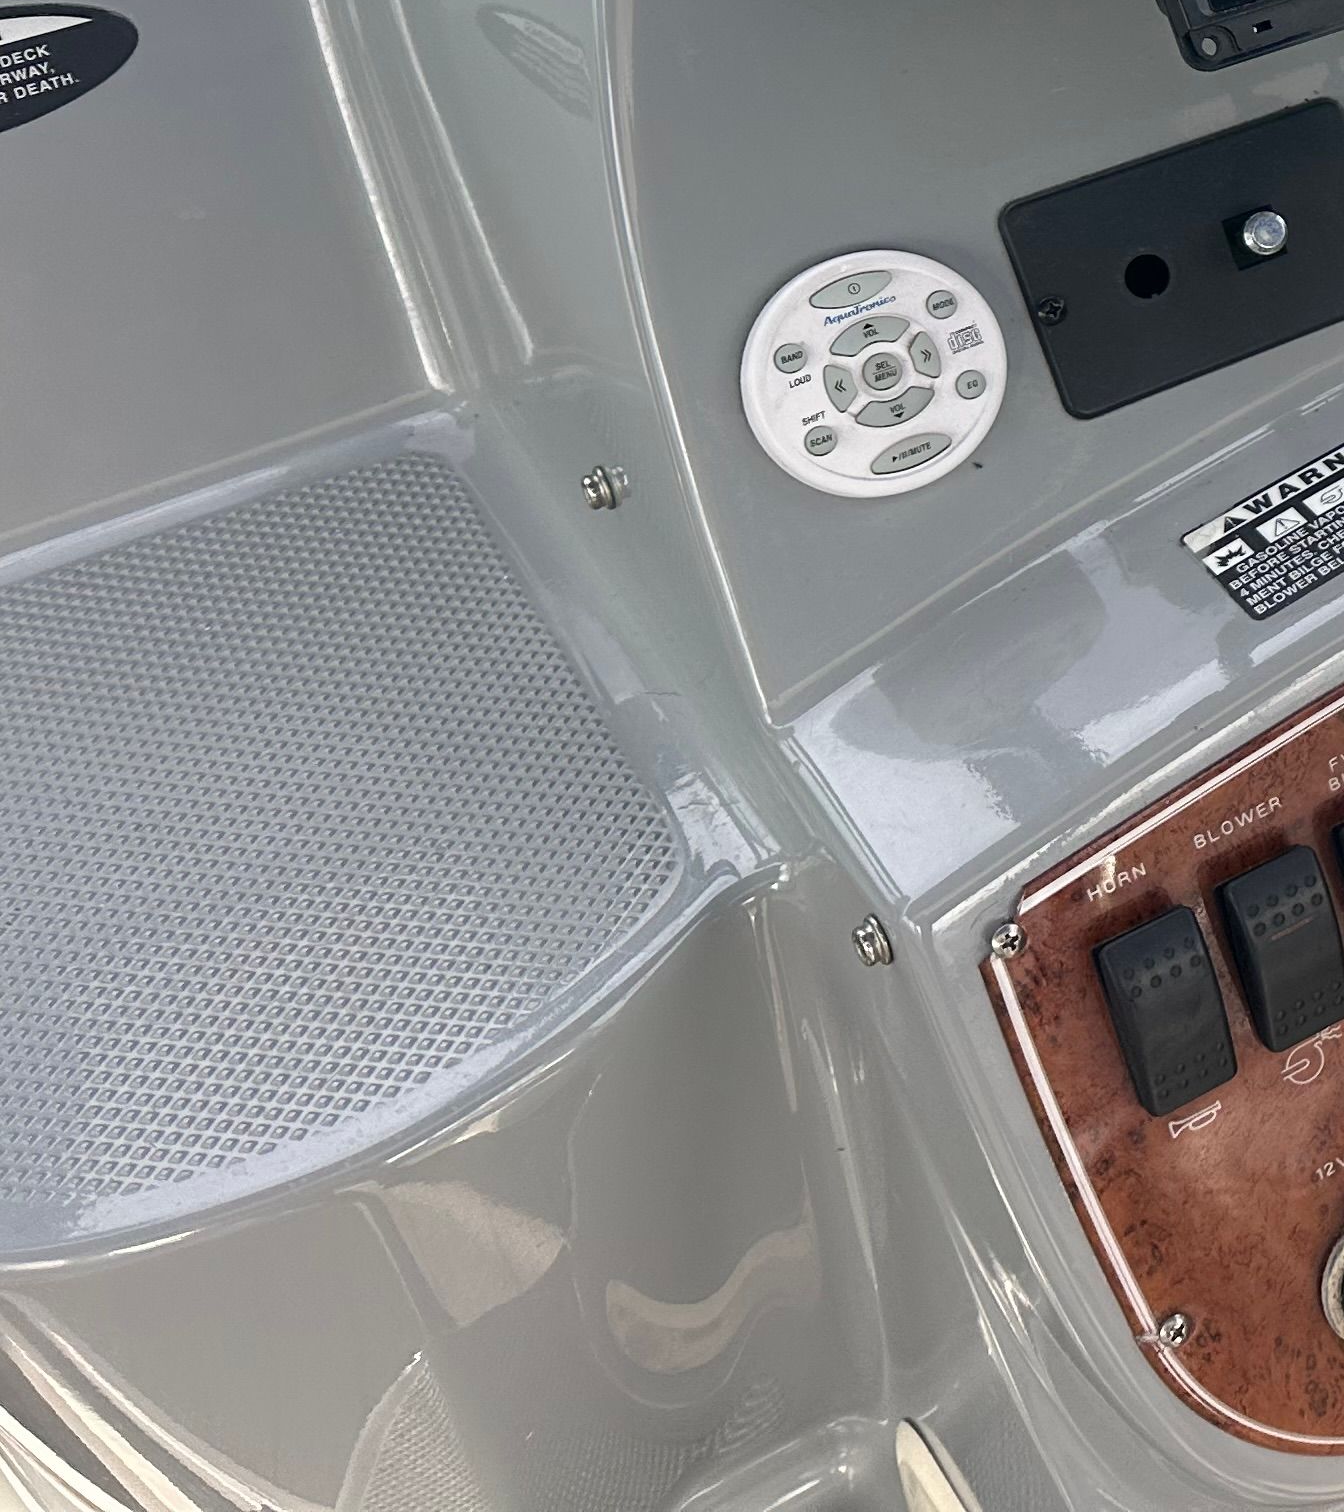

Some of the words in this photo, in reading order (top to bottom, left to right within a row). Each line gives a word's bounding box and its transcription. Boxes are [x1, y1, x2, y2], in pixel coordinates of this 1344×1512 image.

[0, 45, 50, 67] DECK
[0, 61, 55, 86] RWAY,
[14, 73, 80, 99] DEATH.
[863, 328, 879, 339] VOL
[781, 351, 803, 363] BAND
[875, 360, 891, 370] SEL
[789, 374, 811, 389] LOUD
[874, 369, 897, 382] MENU
[967, 380, 978, 389] EQ
[802, 411, 825, 425] SHIFT
[890, 403, 906, 413] VOL
[810, 434, 832, 448] SCAN
[1237, 528, 1309, 573] GASOLINE
[1229, 552, 1289, 590] BEFORE
[1240, 588, 1249, 596] 4
[1250, 550, 1318, 590] MINUTES.
[1246, 577, 1287, 606] MENT
[1288, 551, 1333, 580] BILGE
[1254, 574, 1318, 614] BLOWER
[1194, 796, 1282, 849] BLOWER
[1087, 863, 1147, 902] HORN
